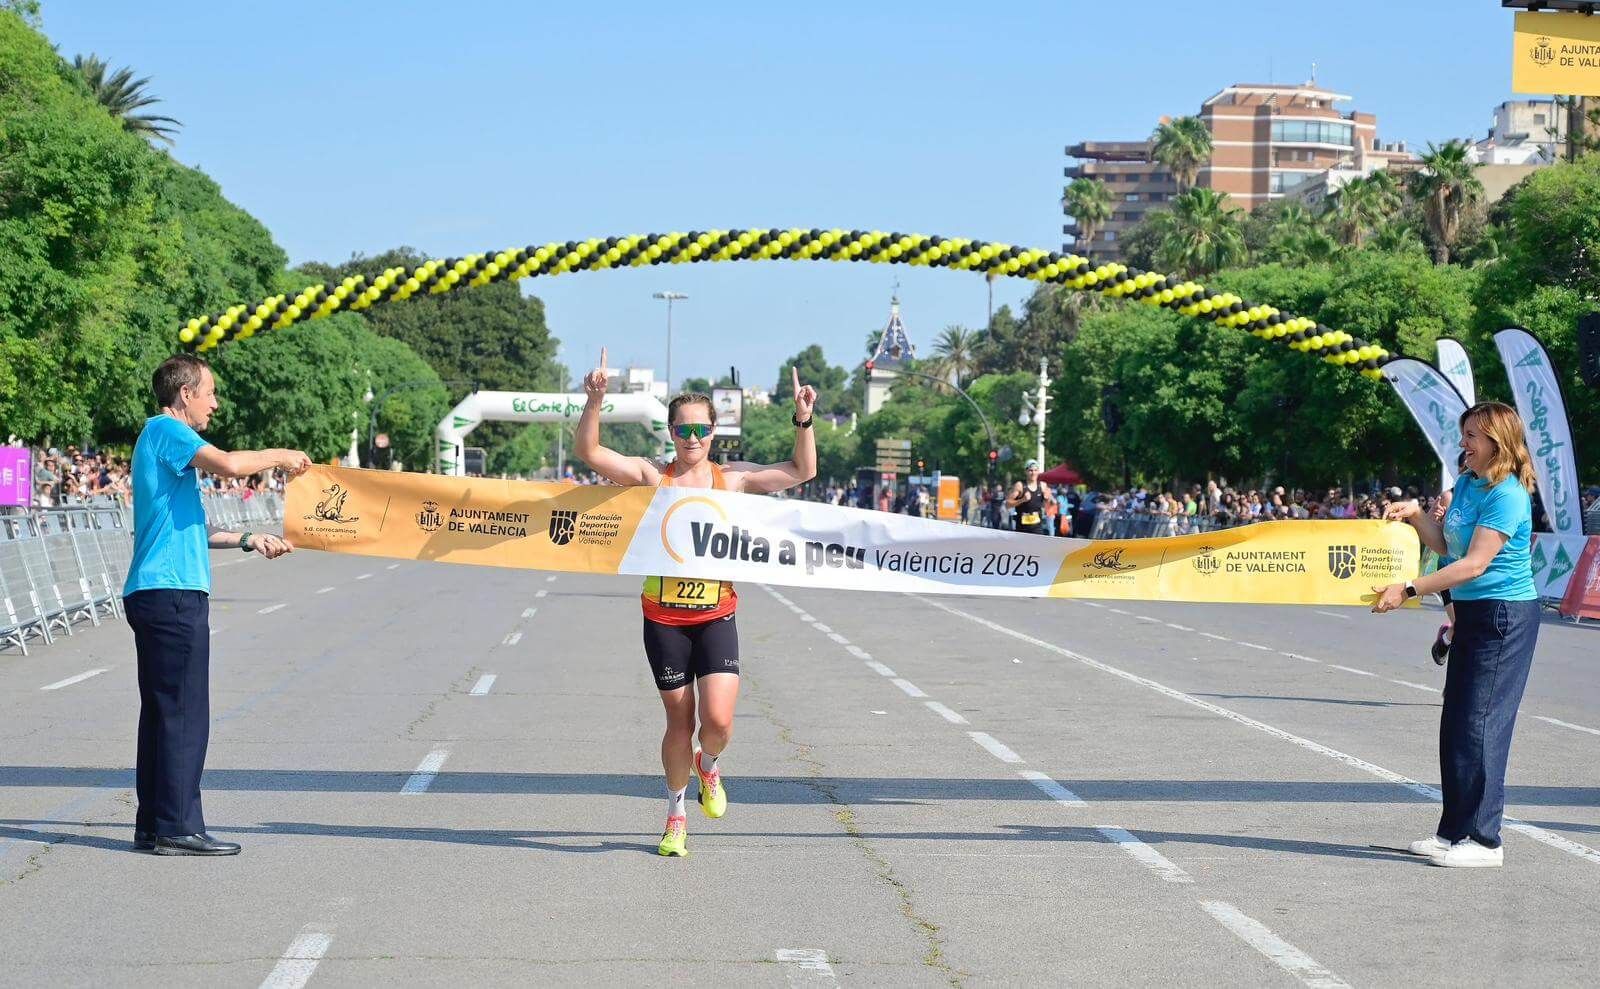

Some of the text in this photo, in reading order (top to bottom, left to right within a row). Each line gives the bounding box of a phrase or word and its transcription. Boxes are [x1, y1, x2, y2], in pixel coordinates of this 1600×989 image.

[1560, 57, 1600, 67] DE VAL
[512, 397, 526, 412] El
[528, 398, 562, 413] Corte
[450, 508, 530, 523] AJUNTAMENT
[580, 513, 622, 521] Fundación
[448, 521, 527, 537] DE VALÈNCIA
[579, 521, 619, 529] Deportiva
[578, 529, 618, 538] Municipal
[691, 521, 1040, 578] Volta a peu València 2025
[1226, 551, 1306, 560] AJUNTAMENT
[1360, 555, 1403, 563] Deportiva
[1226, 561, 1306, 573] DE VALÈNCIA
[1360, 563, 1402, 571] Municipal
[677, 581, 705, 599] 222
